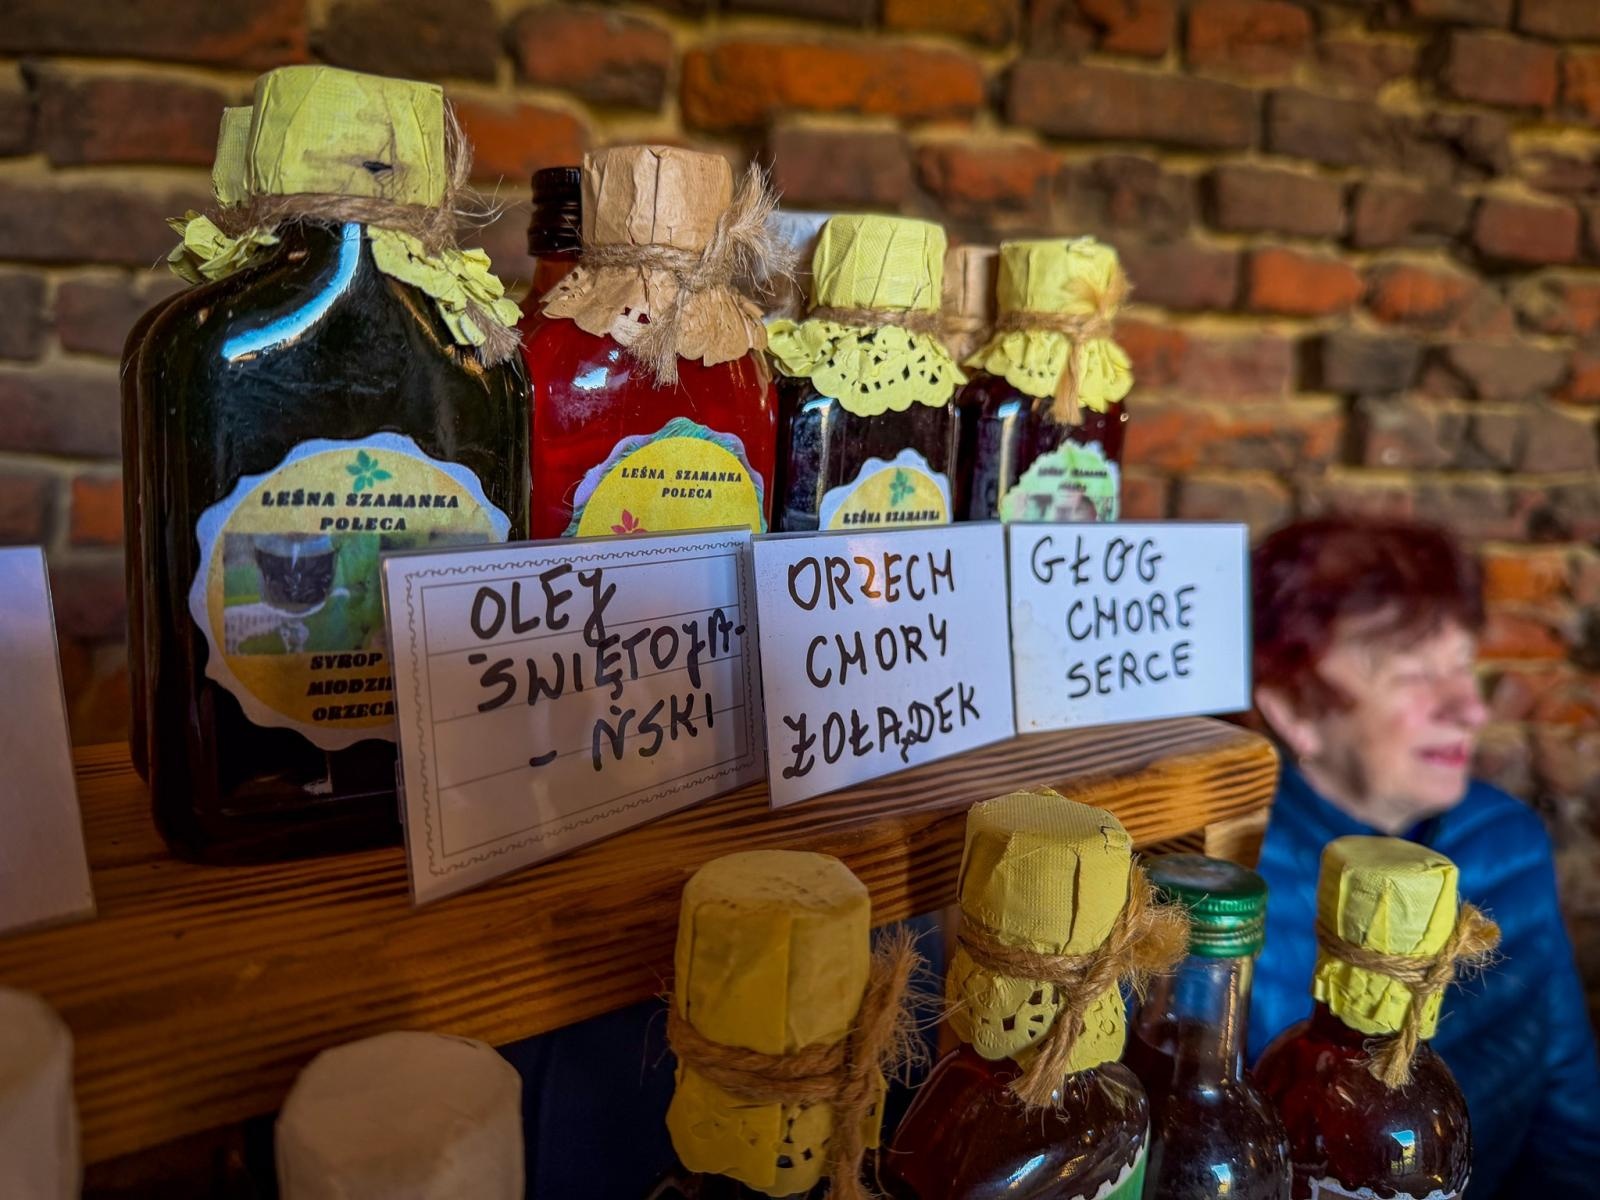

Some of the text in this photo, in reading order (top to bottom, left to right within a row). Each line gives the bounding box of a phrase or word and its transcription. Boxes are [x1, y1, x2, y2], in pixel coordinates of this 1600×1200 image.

[621, 466, 742, 482] LEŚNA SZAMANKA
[261, 487, 459, 508] LEŚNA SZAMANKA
[661, 487, 713, 499] POLECA
[319, 516, 408, 532] POLECA
[787, 548, 955, 611] ORZECH
[1066, 585, 1198, 642] CHORE
[311, 653, 383, 670] SYROP
[805, 613, 948, 689] CHORY
[1067, 642, 1194, 699] SERCE
